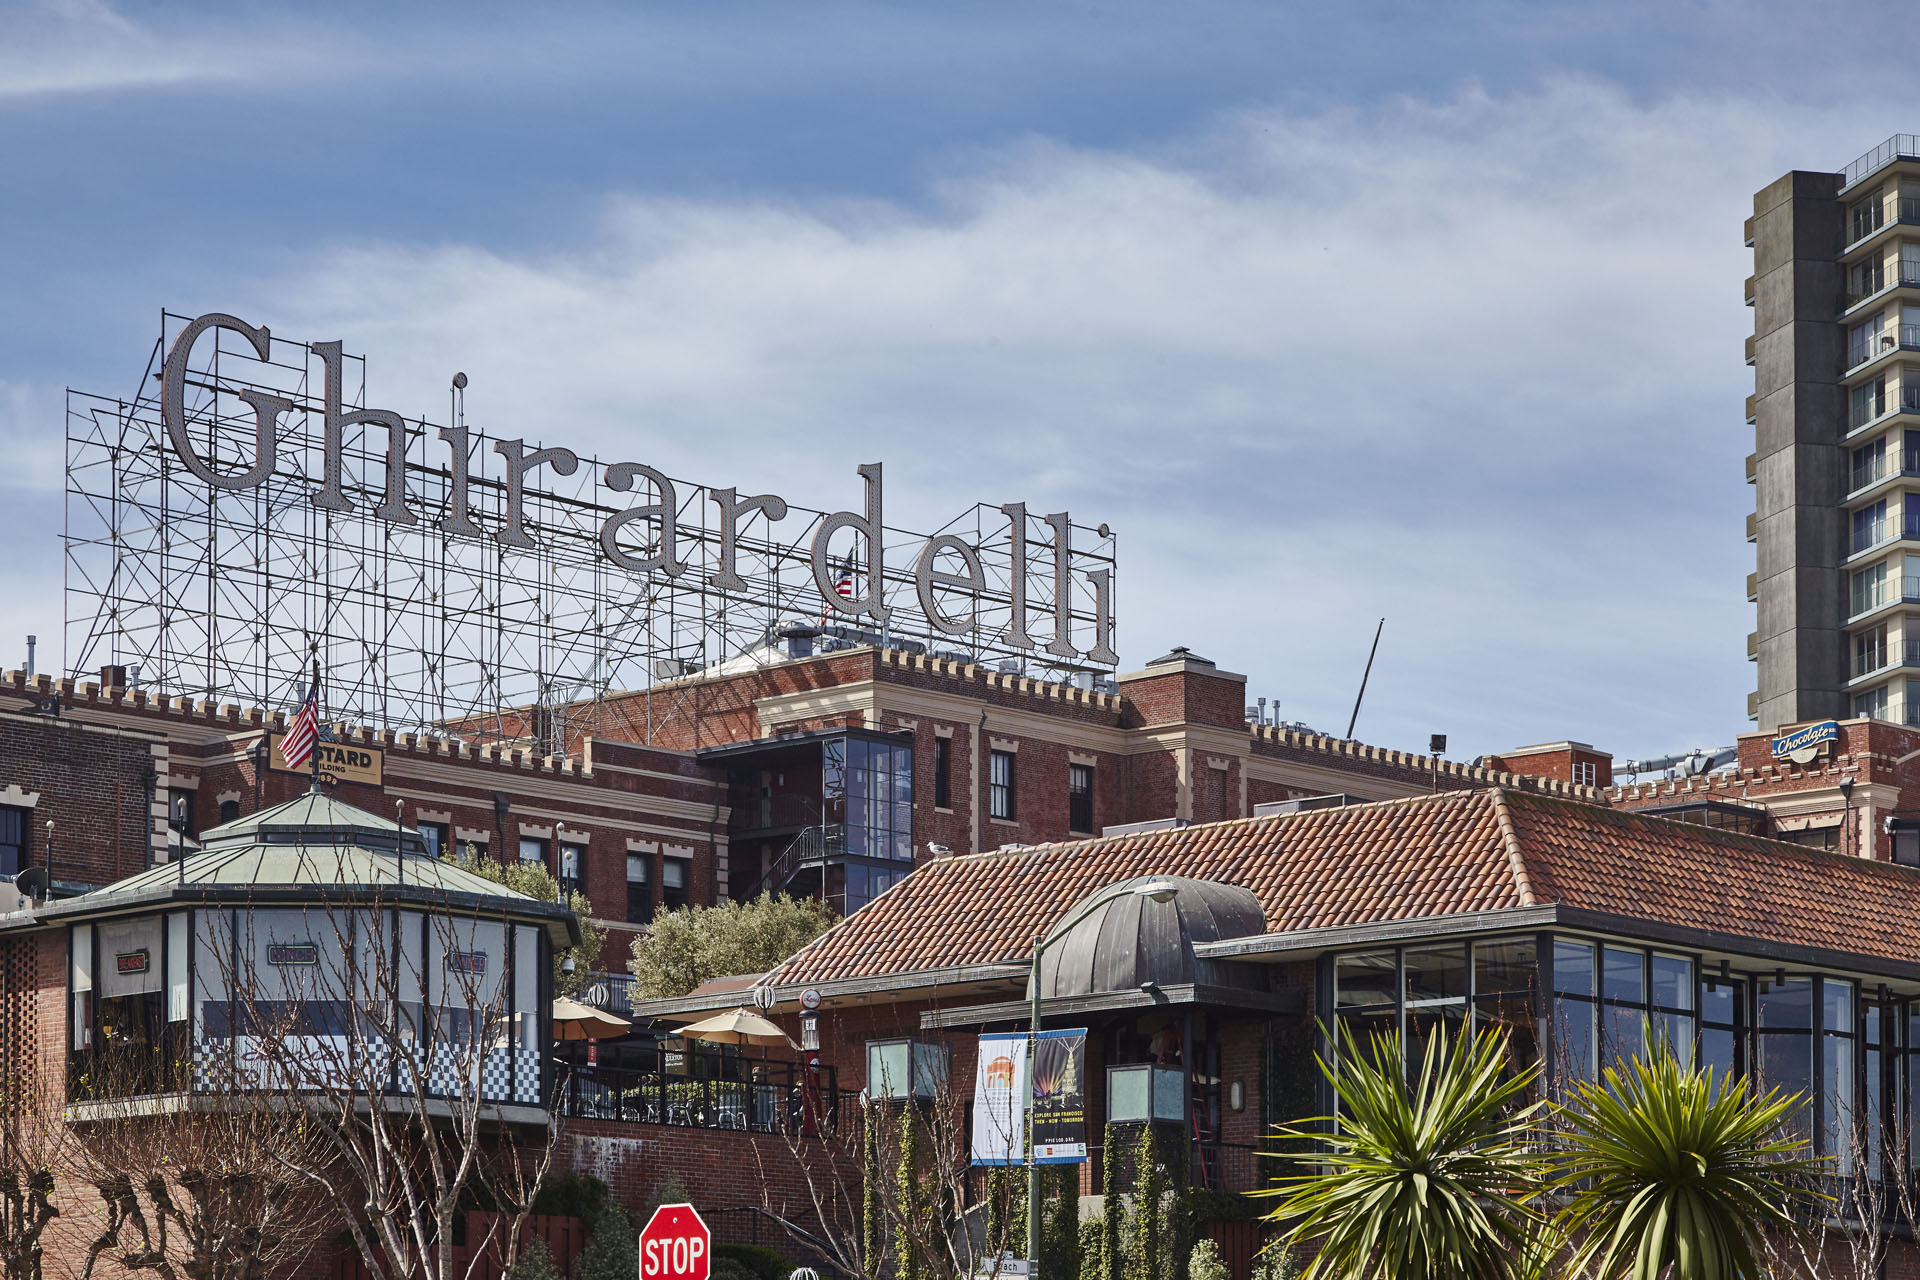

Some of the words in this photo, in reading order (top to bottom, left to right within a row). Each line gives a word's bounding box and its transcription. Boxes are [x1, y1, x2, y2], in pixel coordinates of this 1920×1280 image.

[162, 312, 1120, 666] Ghirardelli
[1778, 725, 1828, 754] Chocolate
[308, 761, 346, 773] BILDING
[317, 745, 372, 768] STARD
[645, 1236, 704, 1276] STOP
